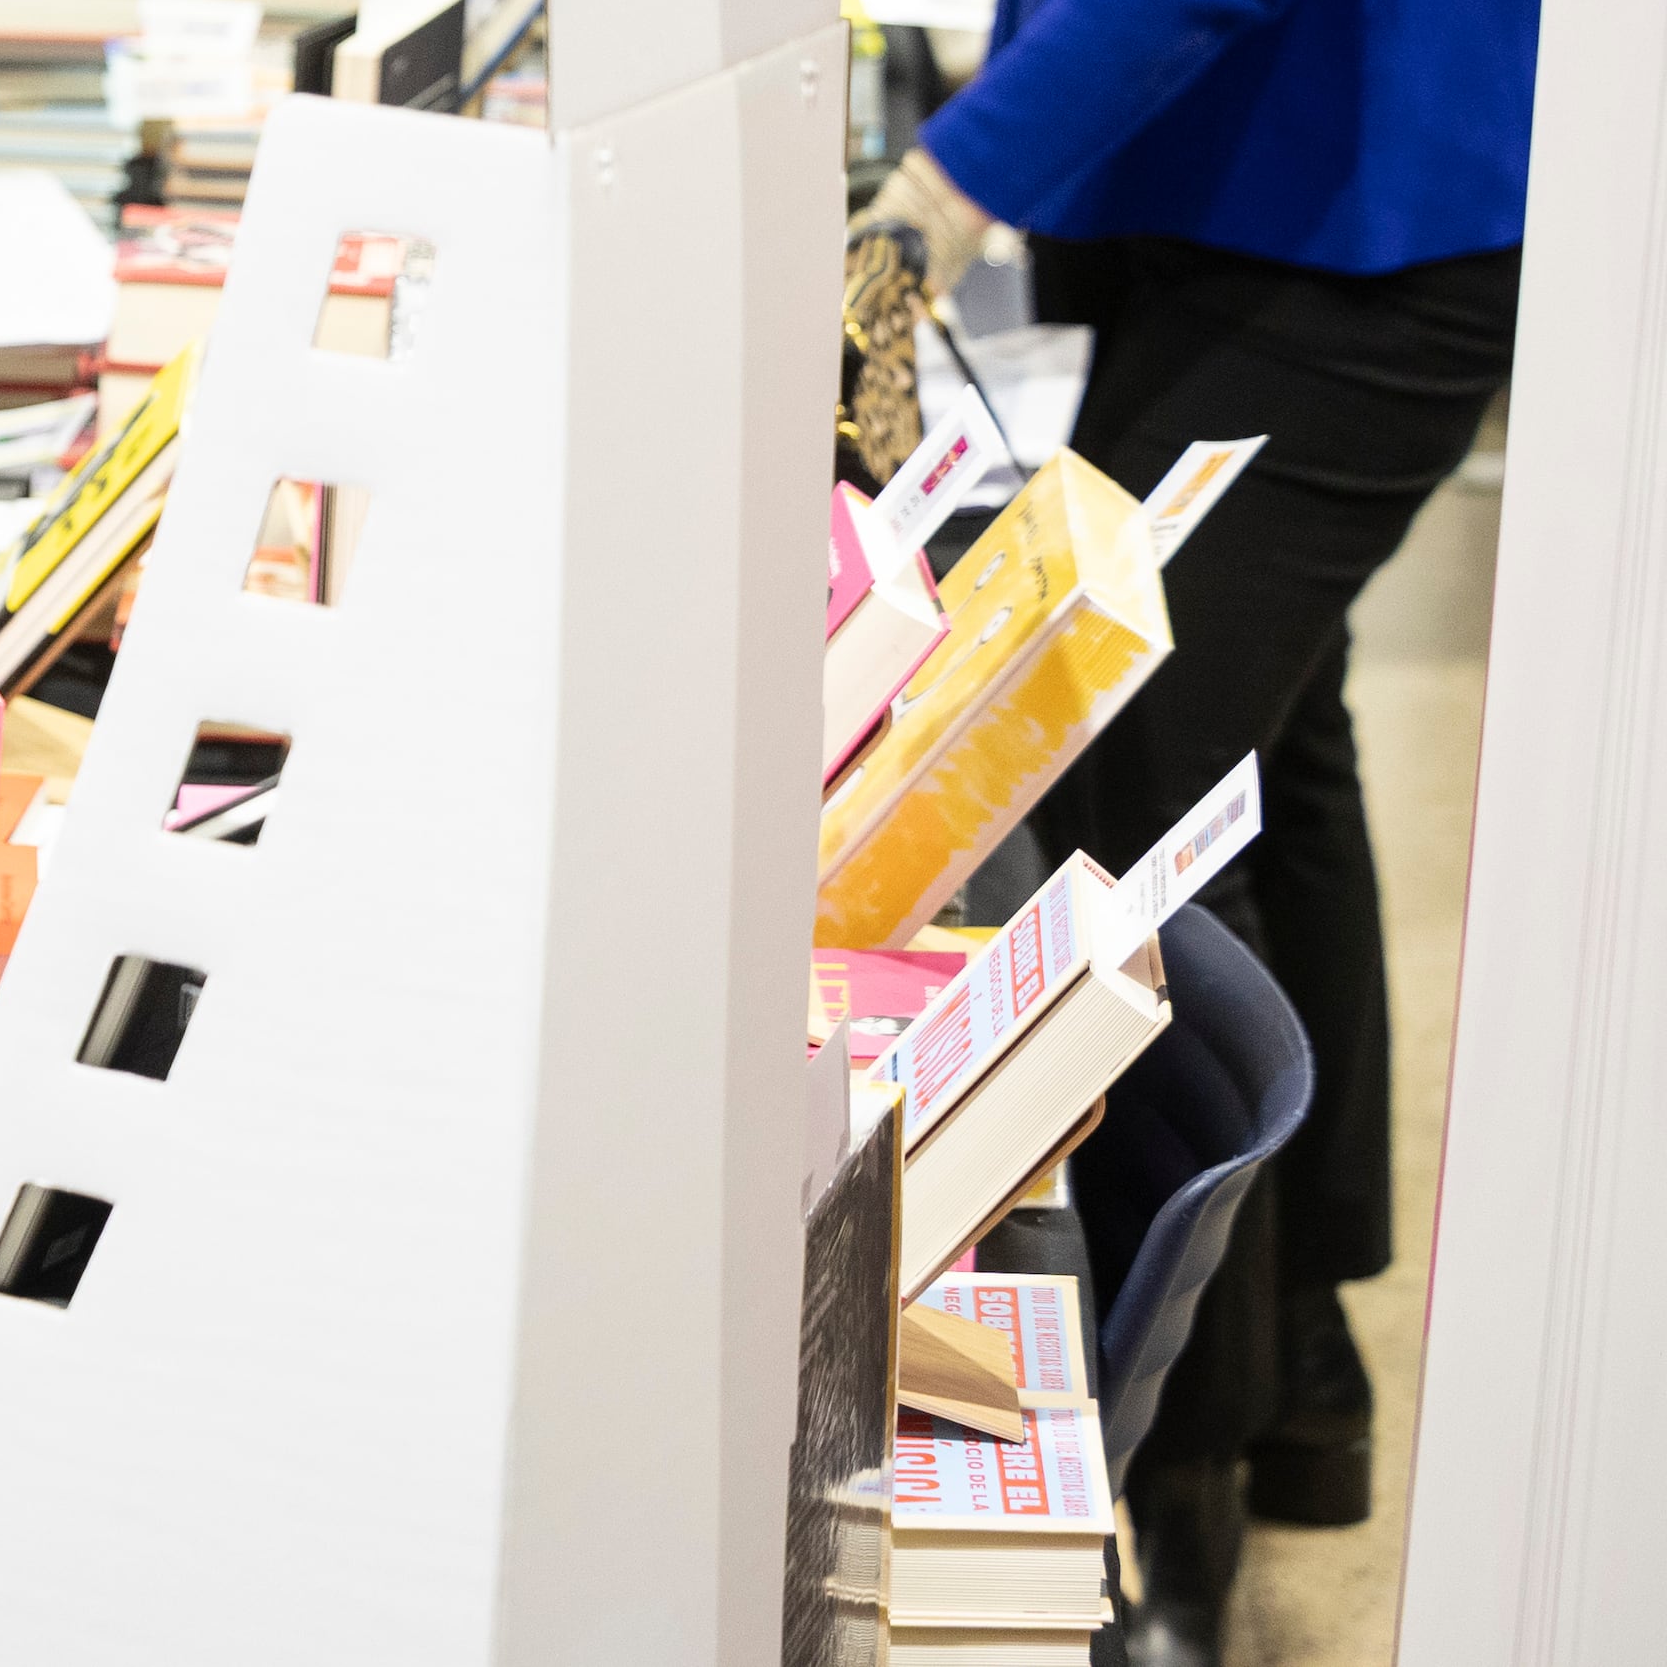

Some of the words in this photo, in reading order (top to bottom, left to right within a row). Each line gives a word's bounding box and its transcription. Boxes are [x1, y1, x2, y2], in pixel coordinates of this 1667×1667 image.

[1012, 911, 1038, 985] SOBRE
[989, 945, 1002, 1002] NEGOCIO
[1017, 972, 1040, 1012] EL
[992, 998, 1003, 1021] DE
[994, 1016, 1004, 1037] LA
[912, 982, 982, 1117] MÚSICA
[1031, 1287, 1056, 1304] TODO
[1034, 1317, 1059, 1331] QUE
[1035, 1332, 1062, 1366] NECESITAS
[1039, 1368, 1065, 1390] SABER
[1050, 1409, 1075, 1426] TODO
[1055, 1441, 1080, 1454] QUE
[969, 1474, 986, 1490] DE
[1057, 1456, 1086, 1492] NECESITAS
[972, 1493, 989, 1511] LA
[1007, 1485, 1042, 1511] EL
[1062, 1494, 1089, 1516] SABER
